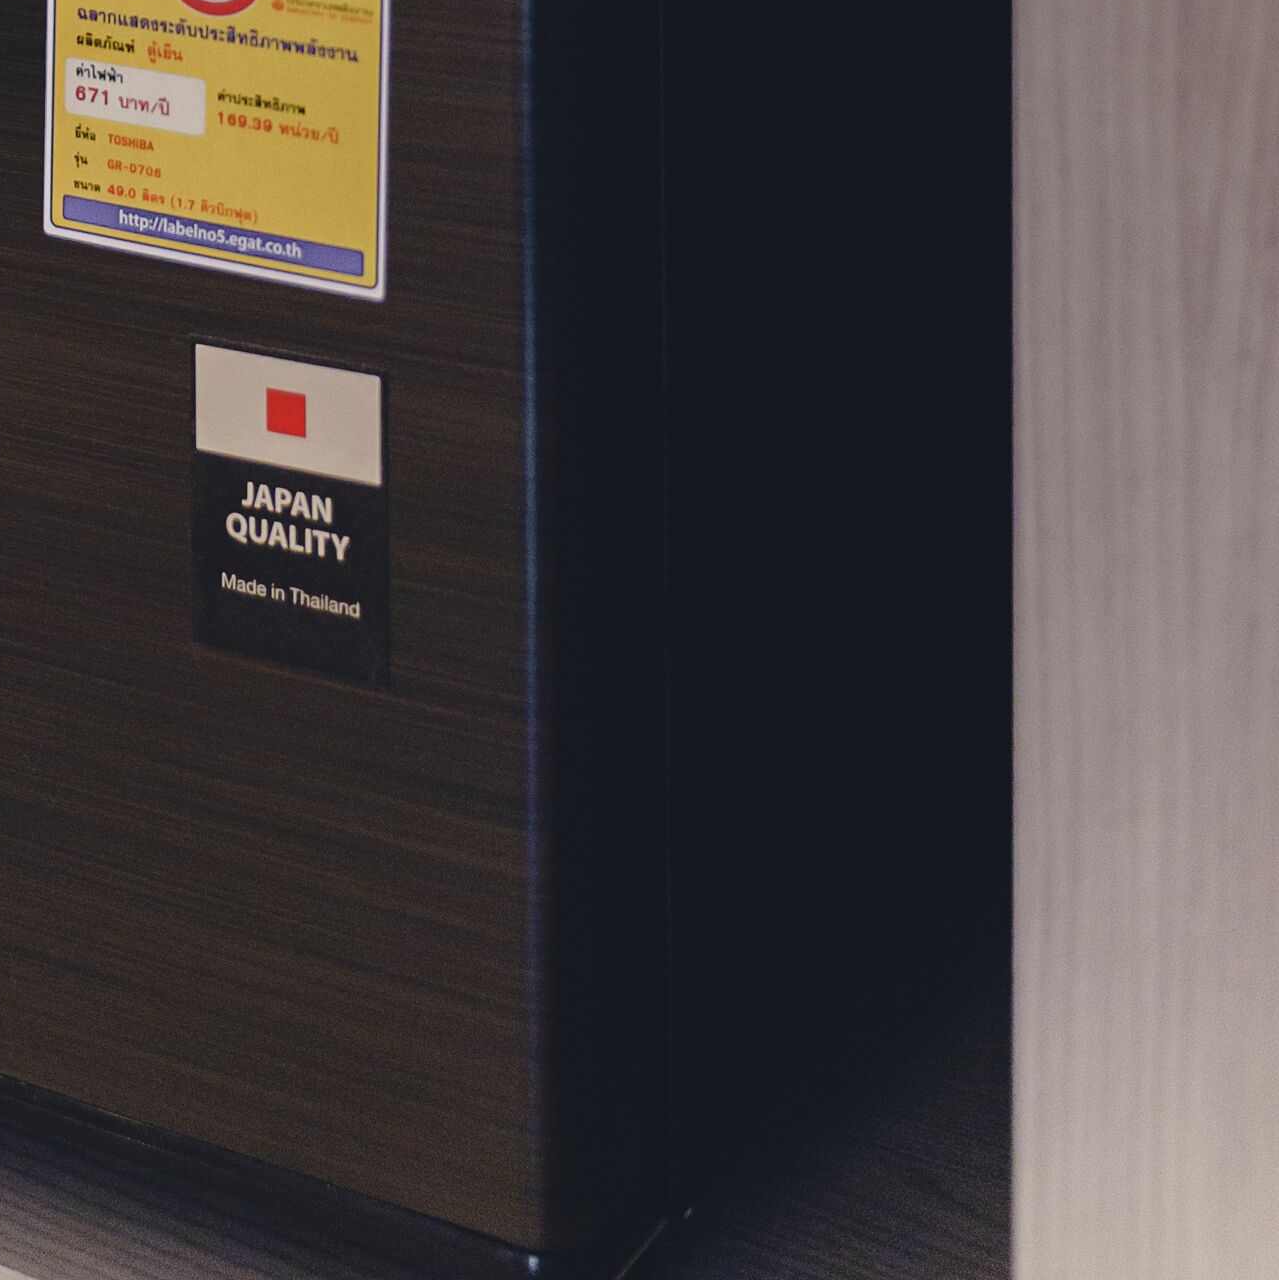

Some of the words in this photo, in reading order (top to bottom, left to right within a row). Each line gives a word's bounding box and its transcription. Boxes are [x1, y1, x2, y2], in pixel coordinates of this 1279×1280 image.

[75, 85, 109, 105] 671
[107, 133, 154, 152] TOSHIBA
[107, 183, 136, 200] 49.0
[119, 209, 302, 260] http://labelno5.egat.co.th
[241, 481, 333, 524] JAPAN
[225, 512, 351, 562] QUALITY
[221, 571, 267, 597] Made
[271, 583, 285, 601] in
[289, 587, 361, 620] Thailand
